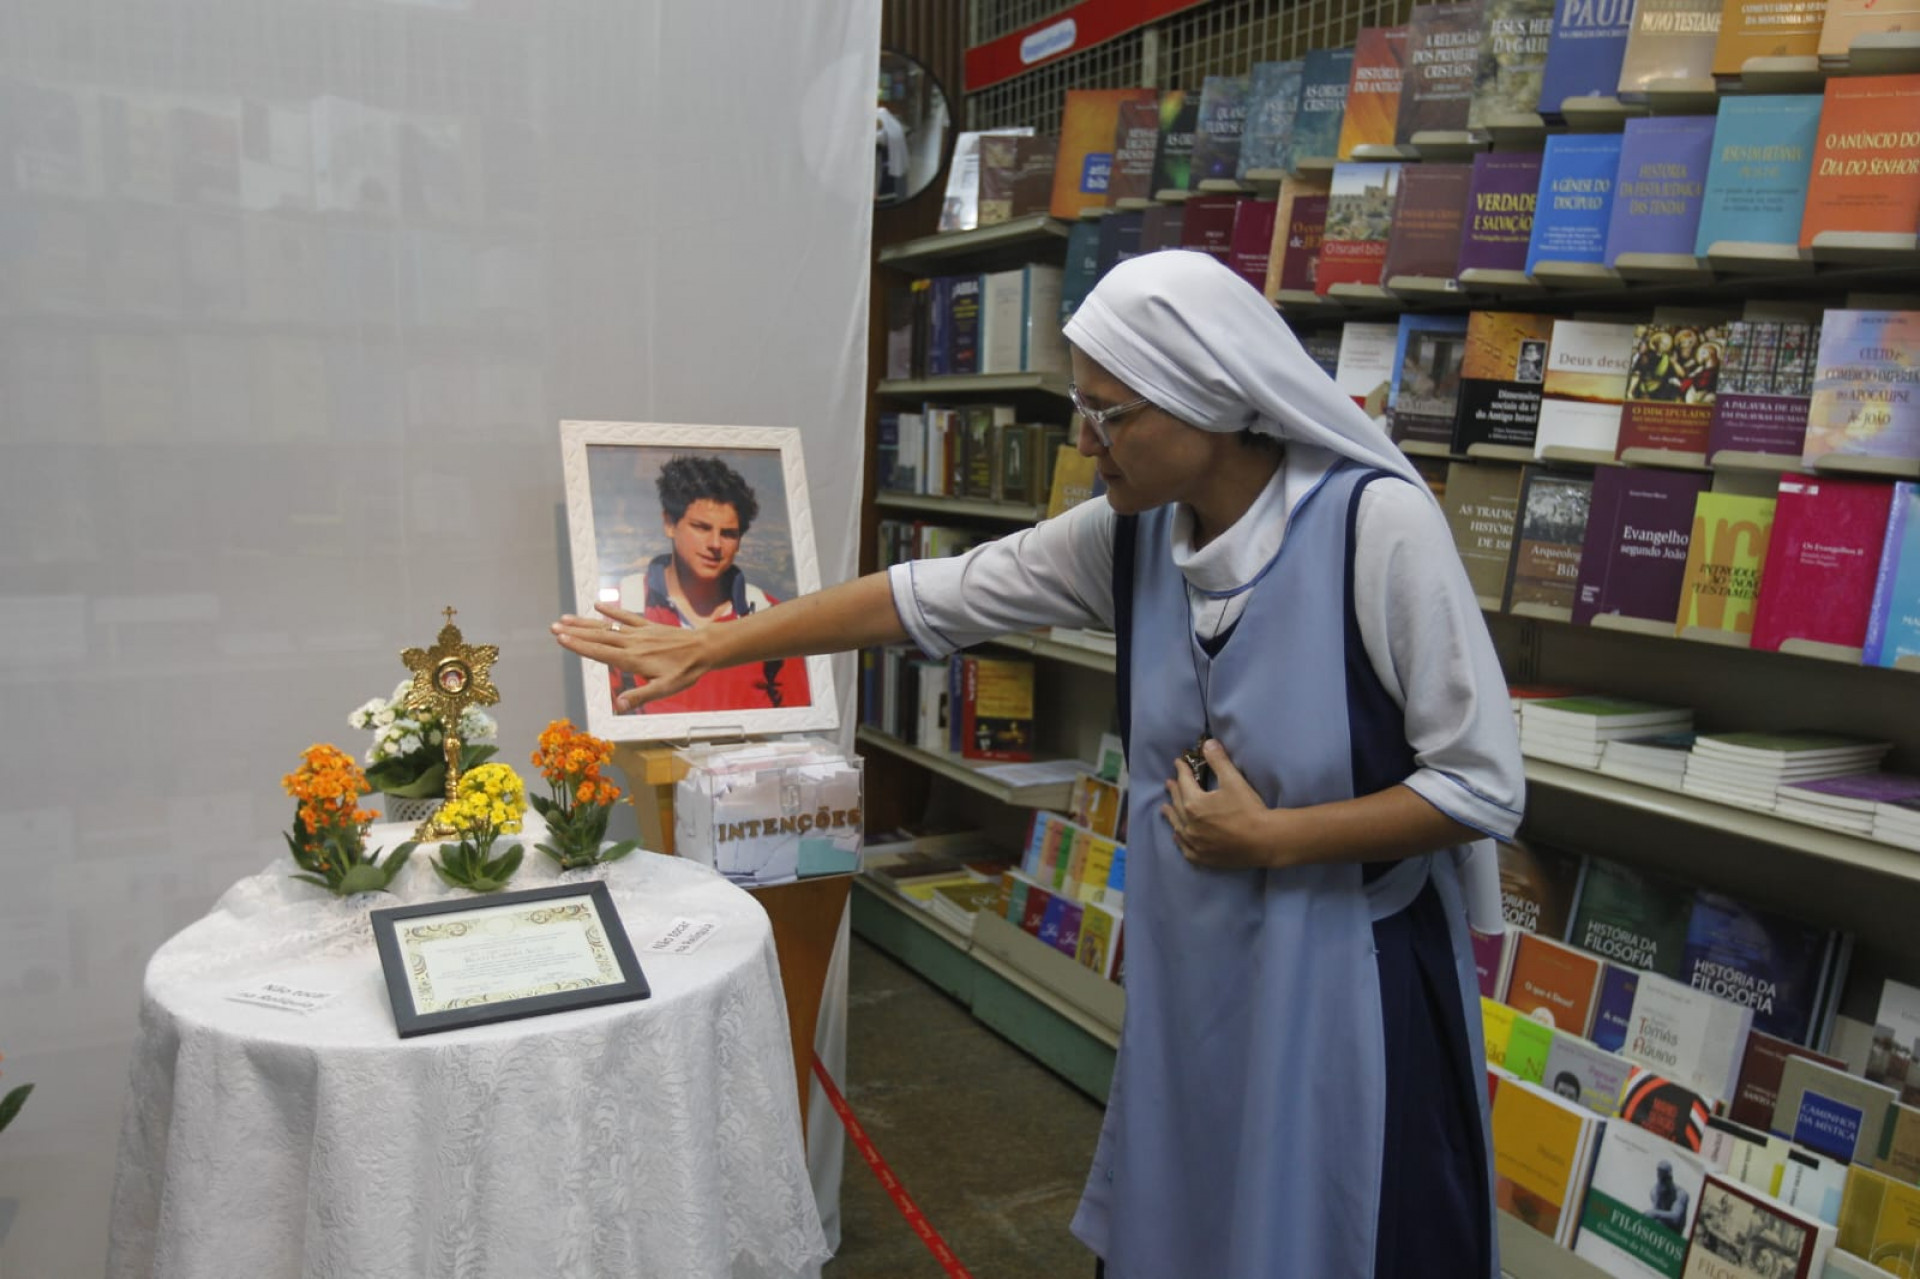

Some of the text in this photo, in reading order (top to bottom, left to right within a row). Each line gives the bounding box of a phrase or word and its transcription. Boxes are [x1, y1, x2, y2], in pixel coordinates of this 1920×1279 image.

[1641, 12, 1674, 31] NOVO
[1825, 134, 1837, 149] O
[1838, 130, 1897, 149] ANÚNCIO
[1819, 159, 1847, 176] DIA
[1867, 156, 1918, 175] SENHOR
[1477, 193, 1536, 213] VERDADE
[1482, 212, 1533, 233] SALVAÇÃO
[1325, 242, 1336, 255] O
[1559, 352, 1594, 367] Deus
[1459, 503, 1474, 515] AS
[1477, 536, 1493, 548] DE
[1623, 525, 1689, 547] Evangelho
[1620, 543, 1687, 560] segundo João
[718, 805, 862, 843] INTENÇÕES
[1525, 898, 1541, 915] DA
[1587, 918, 1657, 956] HISTÓRIA DA
[1583, 932, 1654, 969] FILOSOFIA
[1693, 957, 1777, 998] HISTÓRIA DA
[1690, 971, 1774, 1015] FILOSOFIA
[1639, 1015, 1678, 1047] Tomás
[1633, 1037, 1677, 1067] Aquino
[1799, 1112, 1813, 1126] DA
[1802, 1102, 1858, 1131] CAMINHOS
[1611, 1207, 1685, 1262] FILÓSOFOS
